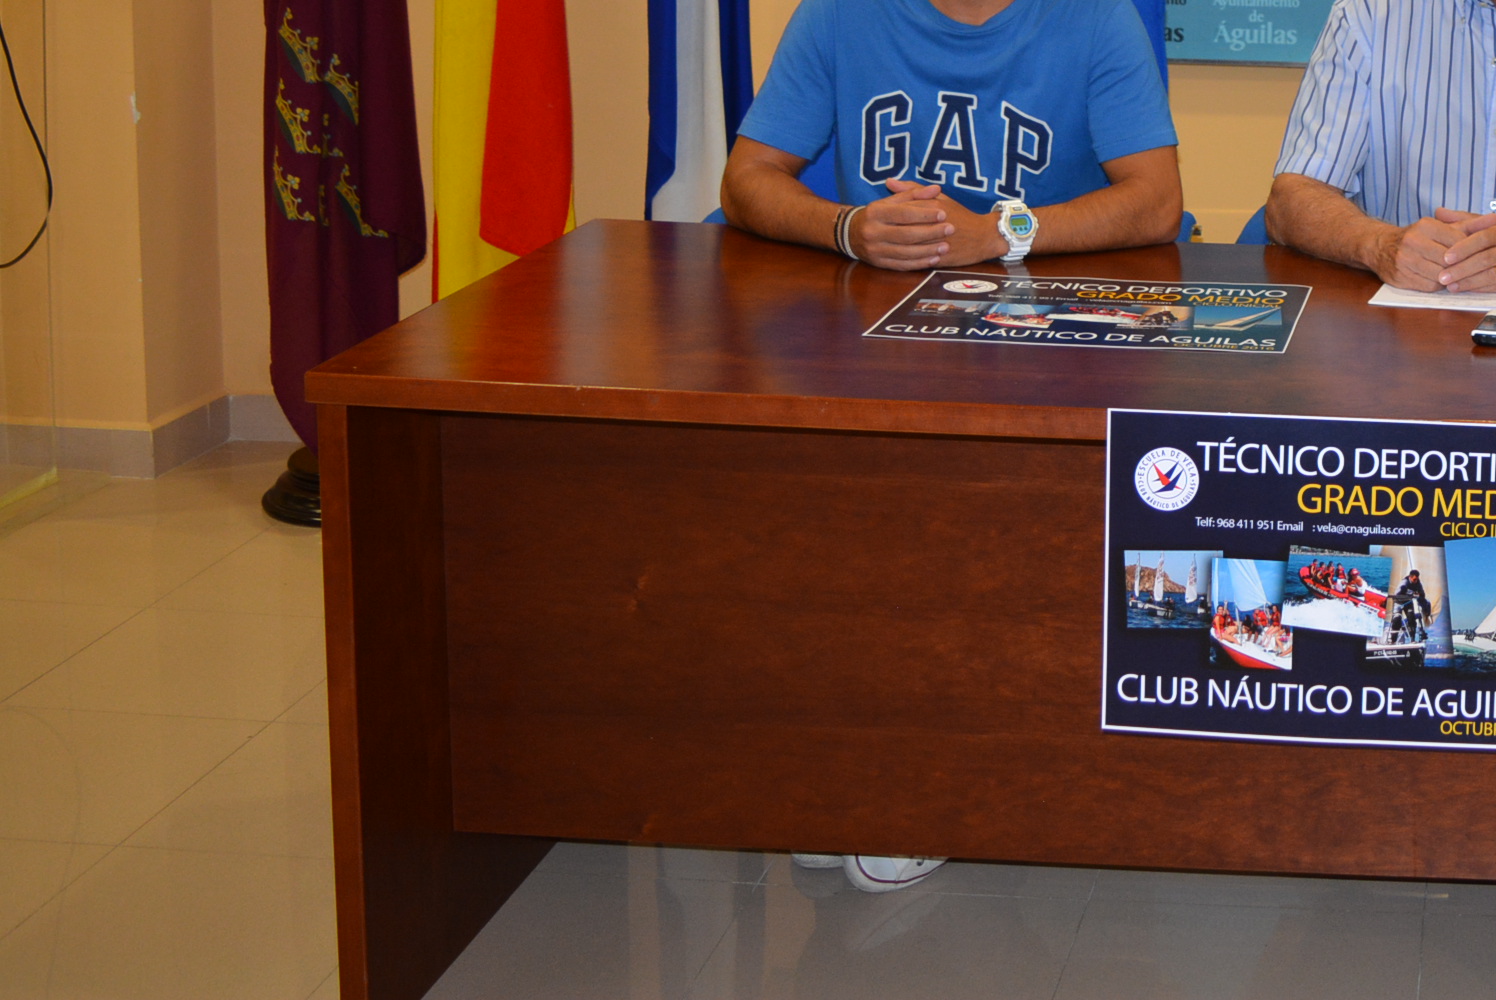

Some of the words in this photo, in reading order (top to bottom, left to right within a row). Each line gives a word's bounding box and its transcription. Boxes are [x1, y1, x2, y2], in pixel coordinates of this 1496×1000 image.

[1249, 8, 1264, 21] de
[1214, 20, 1297, 50] Águilas
[860, 90, 1053, 201] GAP
[1001, 280, 1120, 295] TÉCNICO
[1128, 285, 1287, 298] DEPORTIVO
[1076, 290, 1181, 300] GRADO
[1188, 295, 1284, 304] MEDIO
[885, 324, 960, 334] CLUB
[966, 326, 1098, 340] NÁUTICO
[1104, 334, 1144, 342] DE
[1150, 336, 1276, 347] AGUILAS
[1138, 450, 1166, 476] ESCUELA
[1170, 450, 1180, 458] DE
[1182, 457, 1196, 478] VELA
[1196, 437, 1345, 476] TÉCNICO
[1296, 484, 1423, 517] GRADO
[1196, 517, 1215, 528] Telf:
[1217, 518, 1234, 528] 968
[1236, 519, 1254, 529] 411
[1257, 520, 1274, 530] 951
[1277, 521, 1304, 532] Email
[1317, 523, 1415, 536] vela@cnaguilas.com
[1440, 522, 1488, 538] CICLO
[1117, 674, 1198, 705] CLUB
[1208, 676, 1352, 714] NÁUTICO
[1362, 687, 1404, 716] DE
